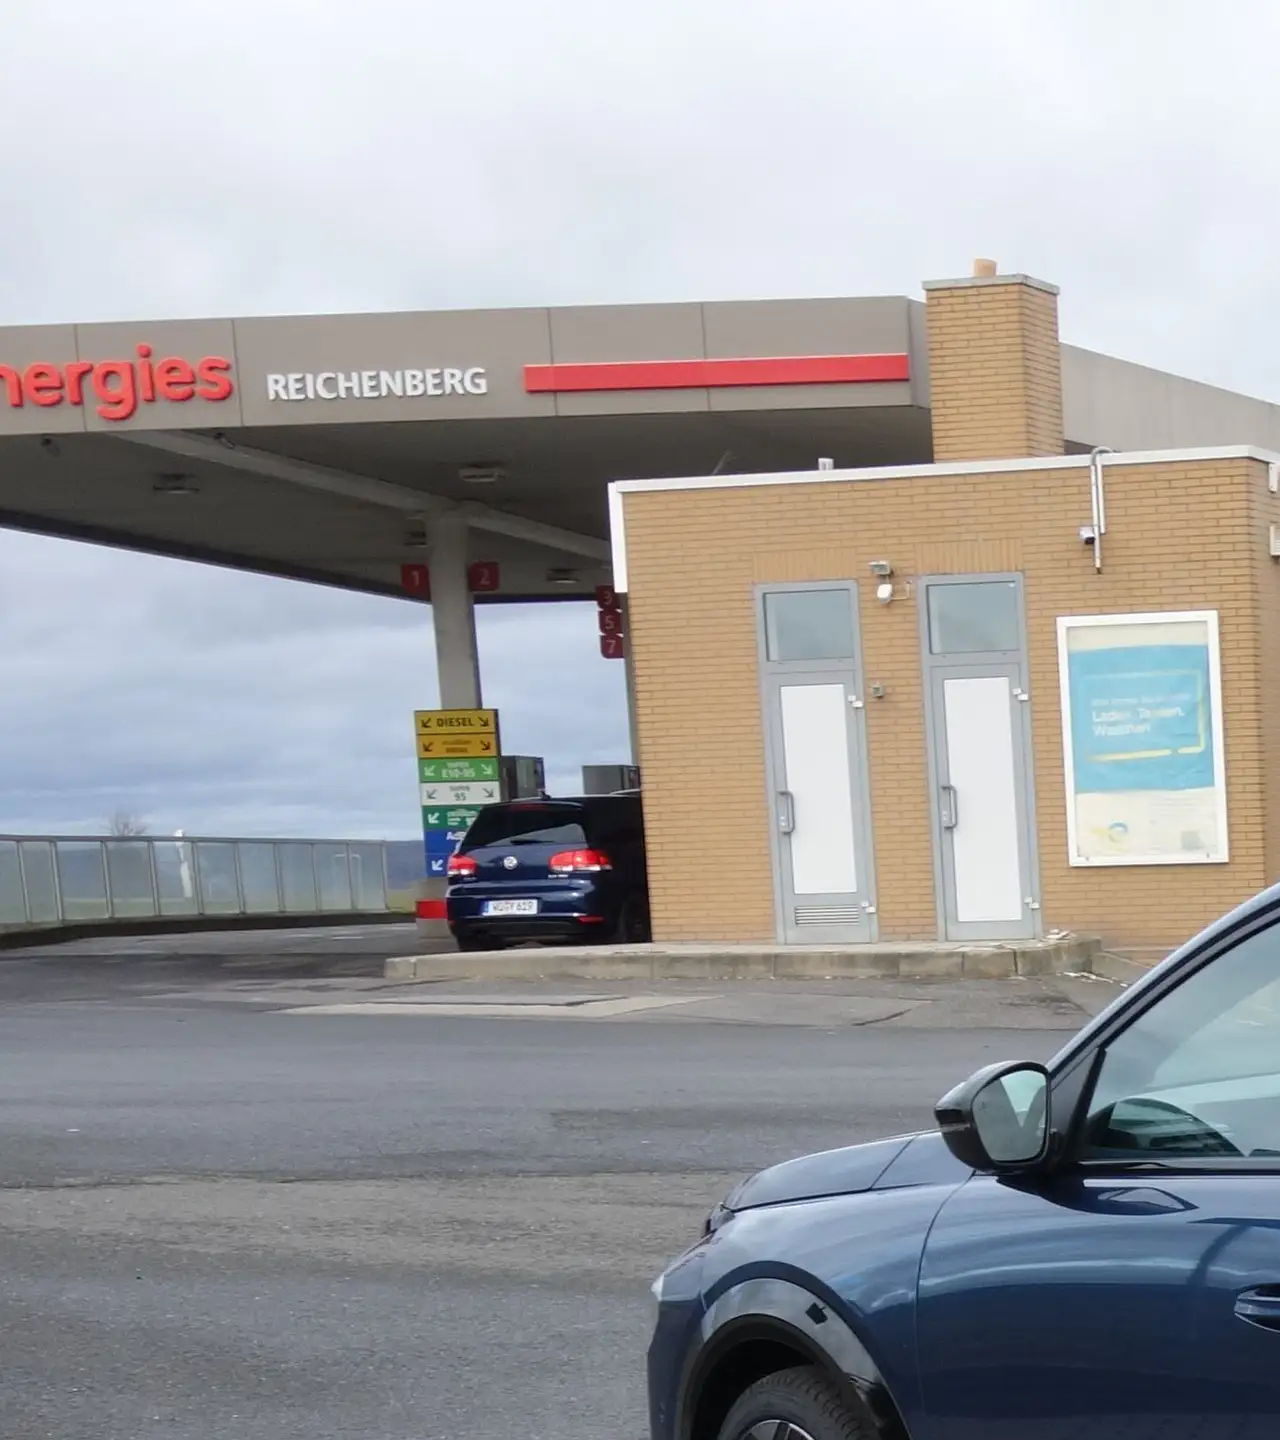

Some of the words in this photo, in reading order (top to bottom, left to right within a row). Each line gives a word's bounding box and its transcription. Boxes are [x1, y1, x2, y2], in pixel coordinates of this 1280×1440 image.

[267, 367, 488, 402] REICHENBERG
[411, 571, 420, 586] 1
[479, 569, 491, 585] 2
[606, 639, 616, 655] 7
[436, 717, 474, 727] DIESEL
